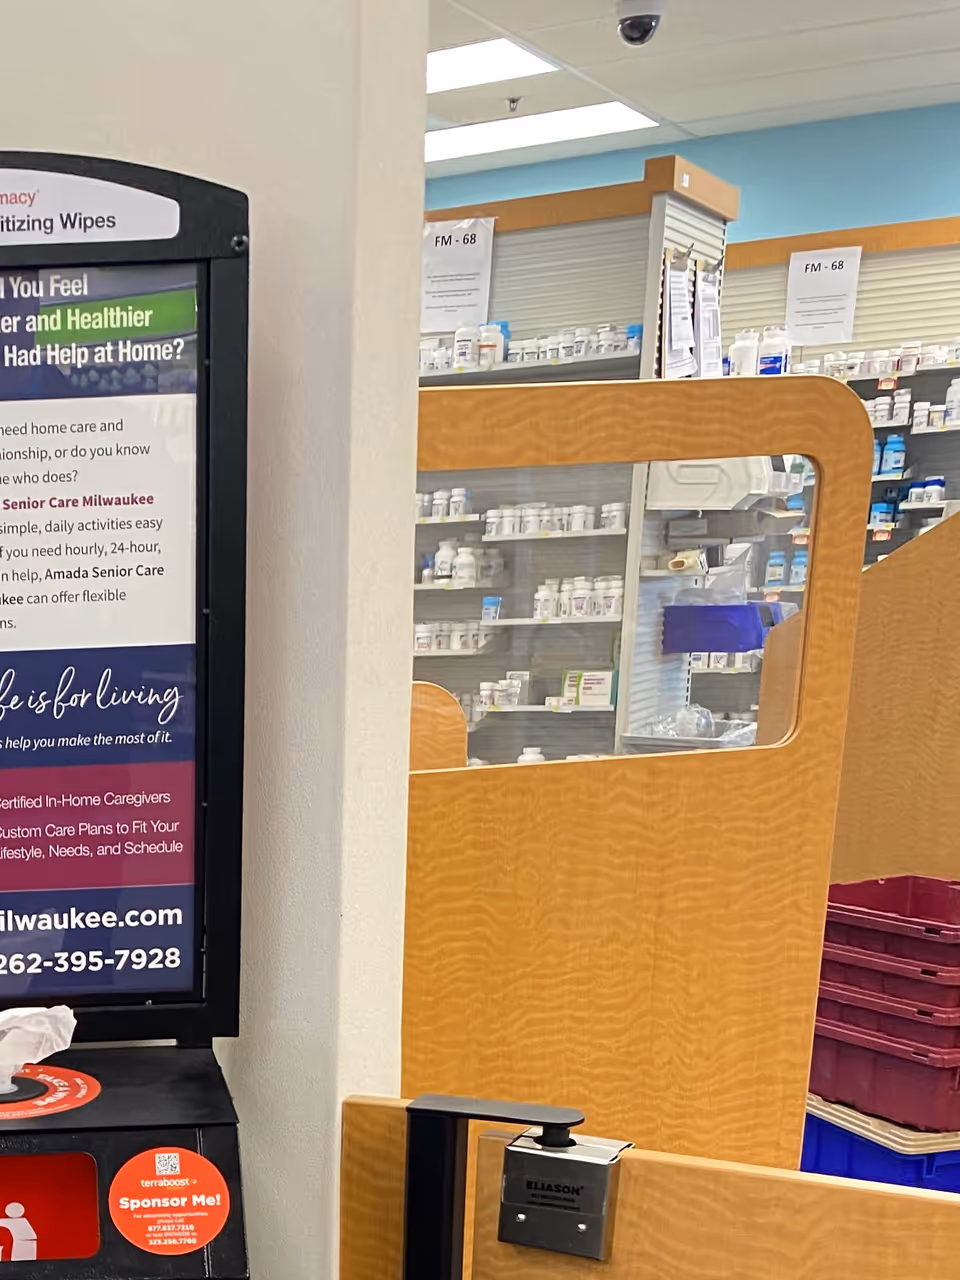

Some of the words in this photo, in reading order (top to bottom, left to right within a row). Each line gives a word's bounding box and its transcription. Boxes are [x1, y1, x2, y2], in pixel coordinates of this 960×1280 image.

[59, 212, 116, 233] Wipes
[435, 235, 452, 247] FM
[463, 233, 477, 245] 68
[804, 262, 822, 273] FM
[831, 260, 844, 271] 68
[8, 276, 44, 299] You
[49, 273, 88, 297] Feel
[25, 309, 62, 332] and
[66, 306, 154, 331] Healthier
[4, 344, 41, 368] Had
[46, 343, 89, 369] Help
[93, 341, 114, 364] at
[118, 337, 185, 363] Home?
[31, 421, 67, 435] home
[69, 422, 97, 434] care
[99, 418, 124, 432] and
[2, 496, 46, 511] Senior
[48, 496, 79, 509] Care
[82, 493, 154, 507] Milwaukee
[28, 684, 51, 712] is
[49, 666, 92, 719] for
[97, 667, 184, 724] living
[45, 793, 101, 808] In-Home
[102, 790, 171, 808] Caregivers
[44, 823, 76, 837] Care
[77, 822, 114, 836] Plans
[115, 822, 130, 835] to
[132, 820, 147, 834] Fit
[149, 819, 180, 833] Your
[140, 1178, 190, 1187] terraboost
[526, 1181, 581, 1196] ELIASON
[119, 1196, 188, 1211] Sponsor
[192, 1194, 221, 1206] Me!
